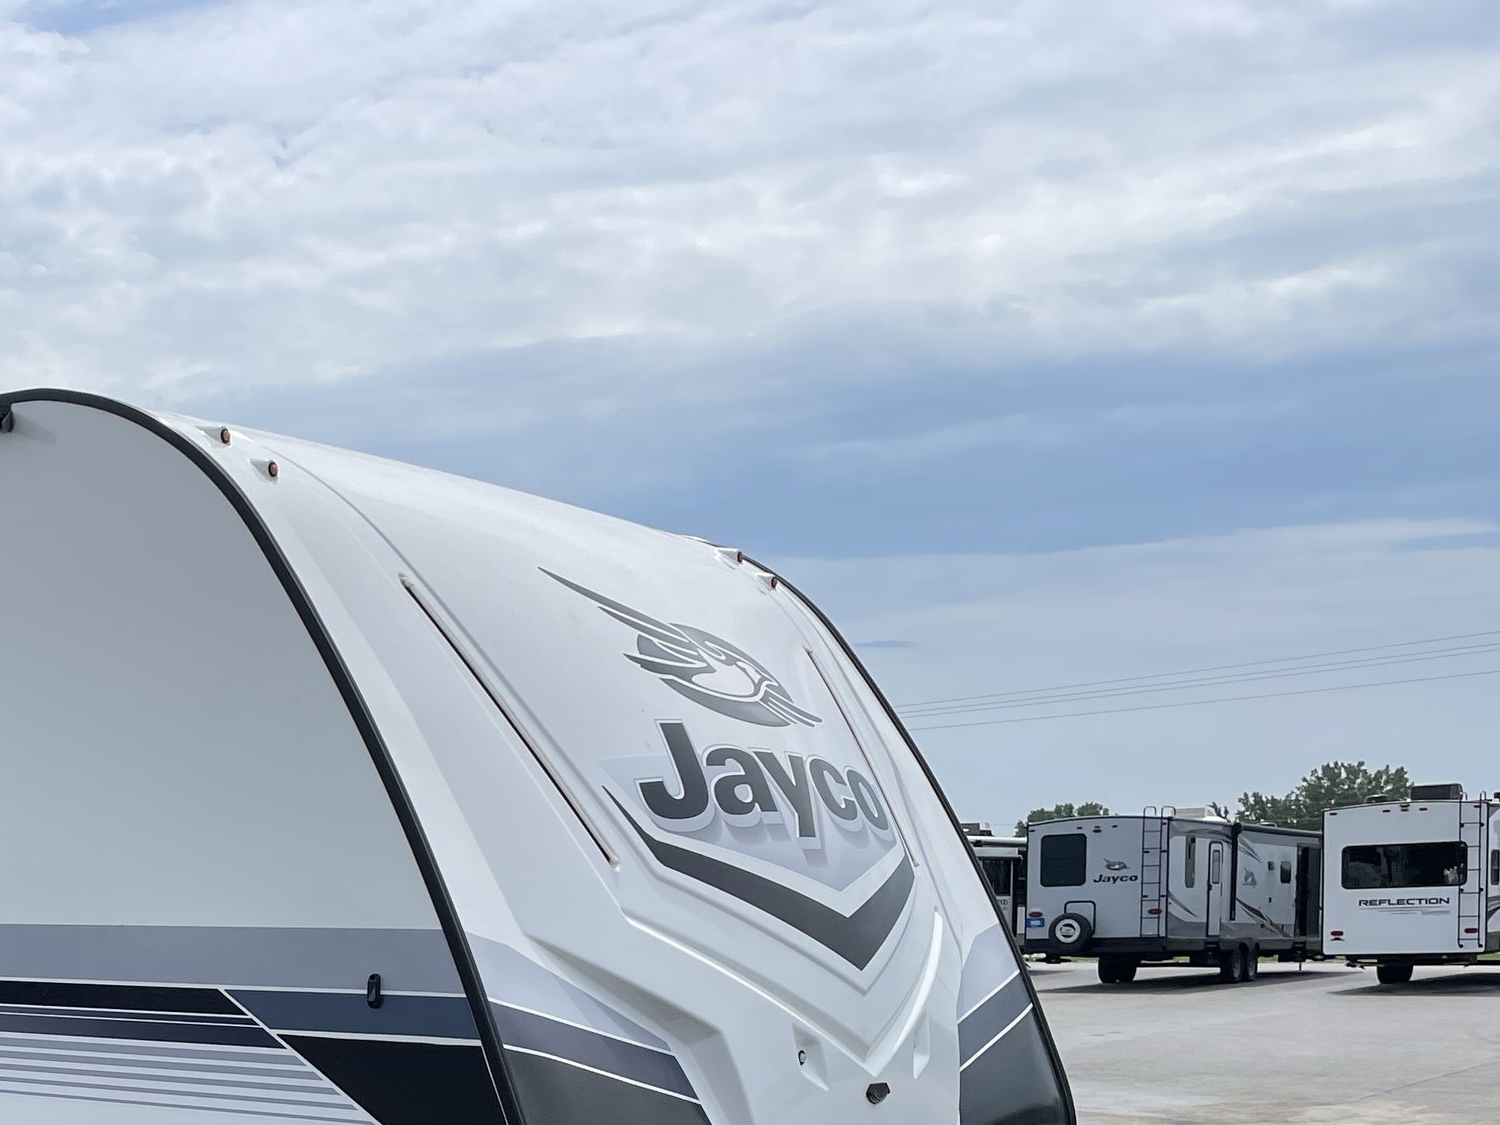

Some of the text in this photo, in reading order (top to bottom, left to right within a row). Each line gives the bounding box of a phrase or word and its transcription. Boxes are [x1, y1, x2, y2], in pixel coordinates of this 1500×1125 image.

[636, 719, 892, 842] Jayco
[1093, 874, 1139, 885] Jayco
[1358, 897, 1451, 907] REFLECTION
